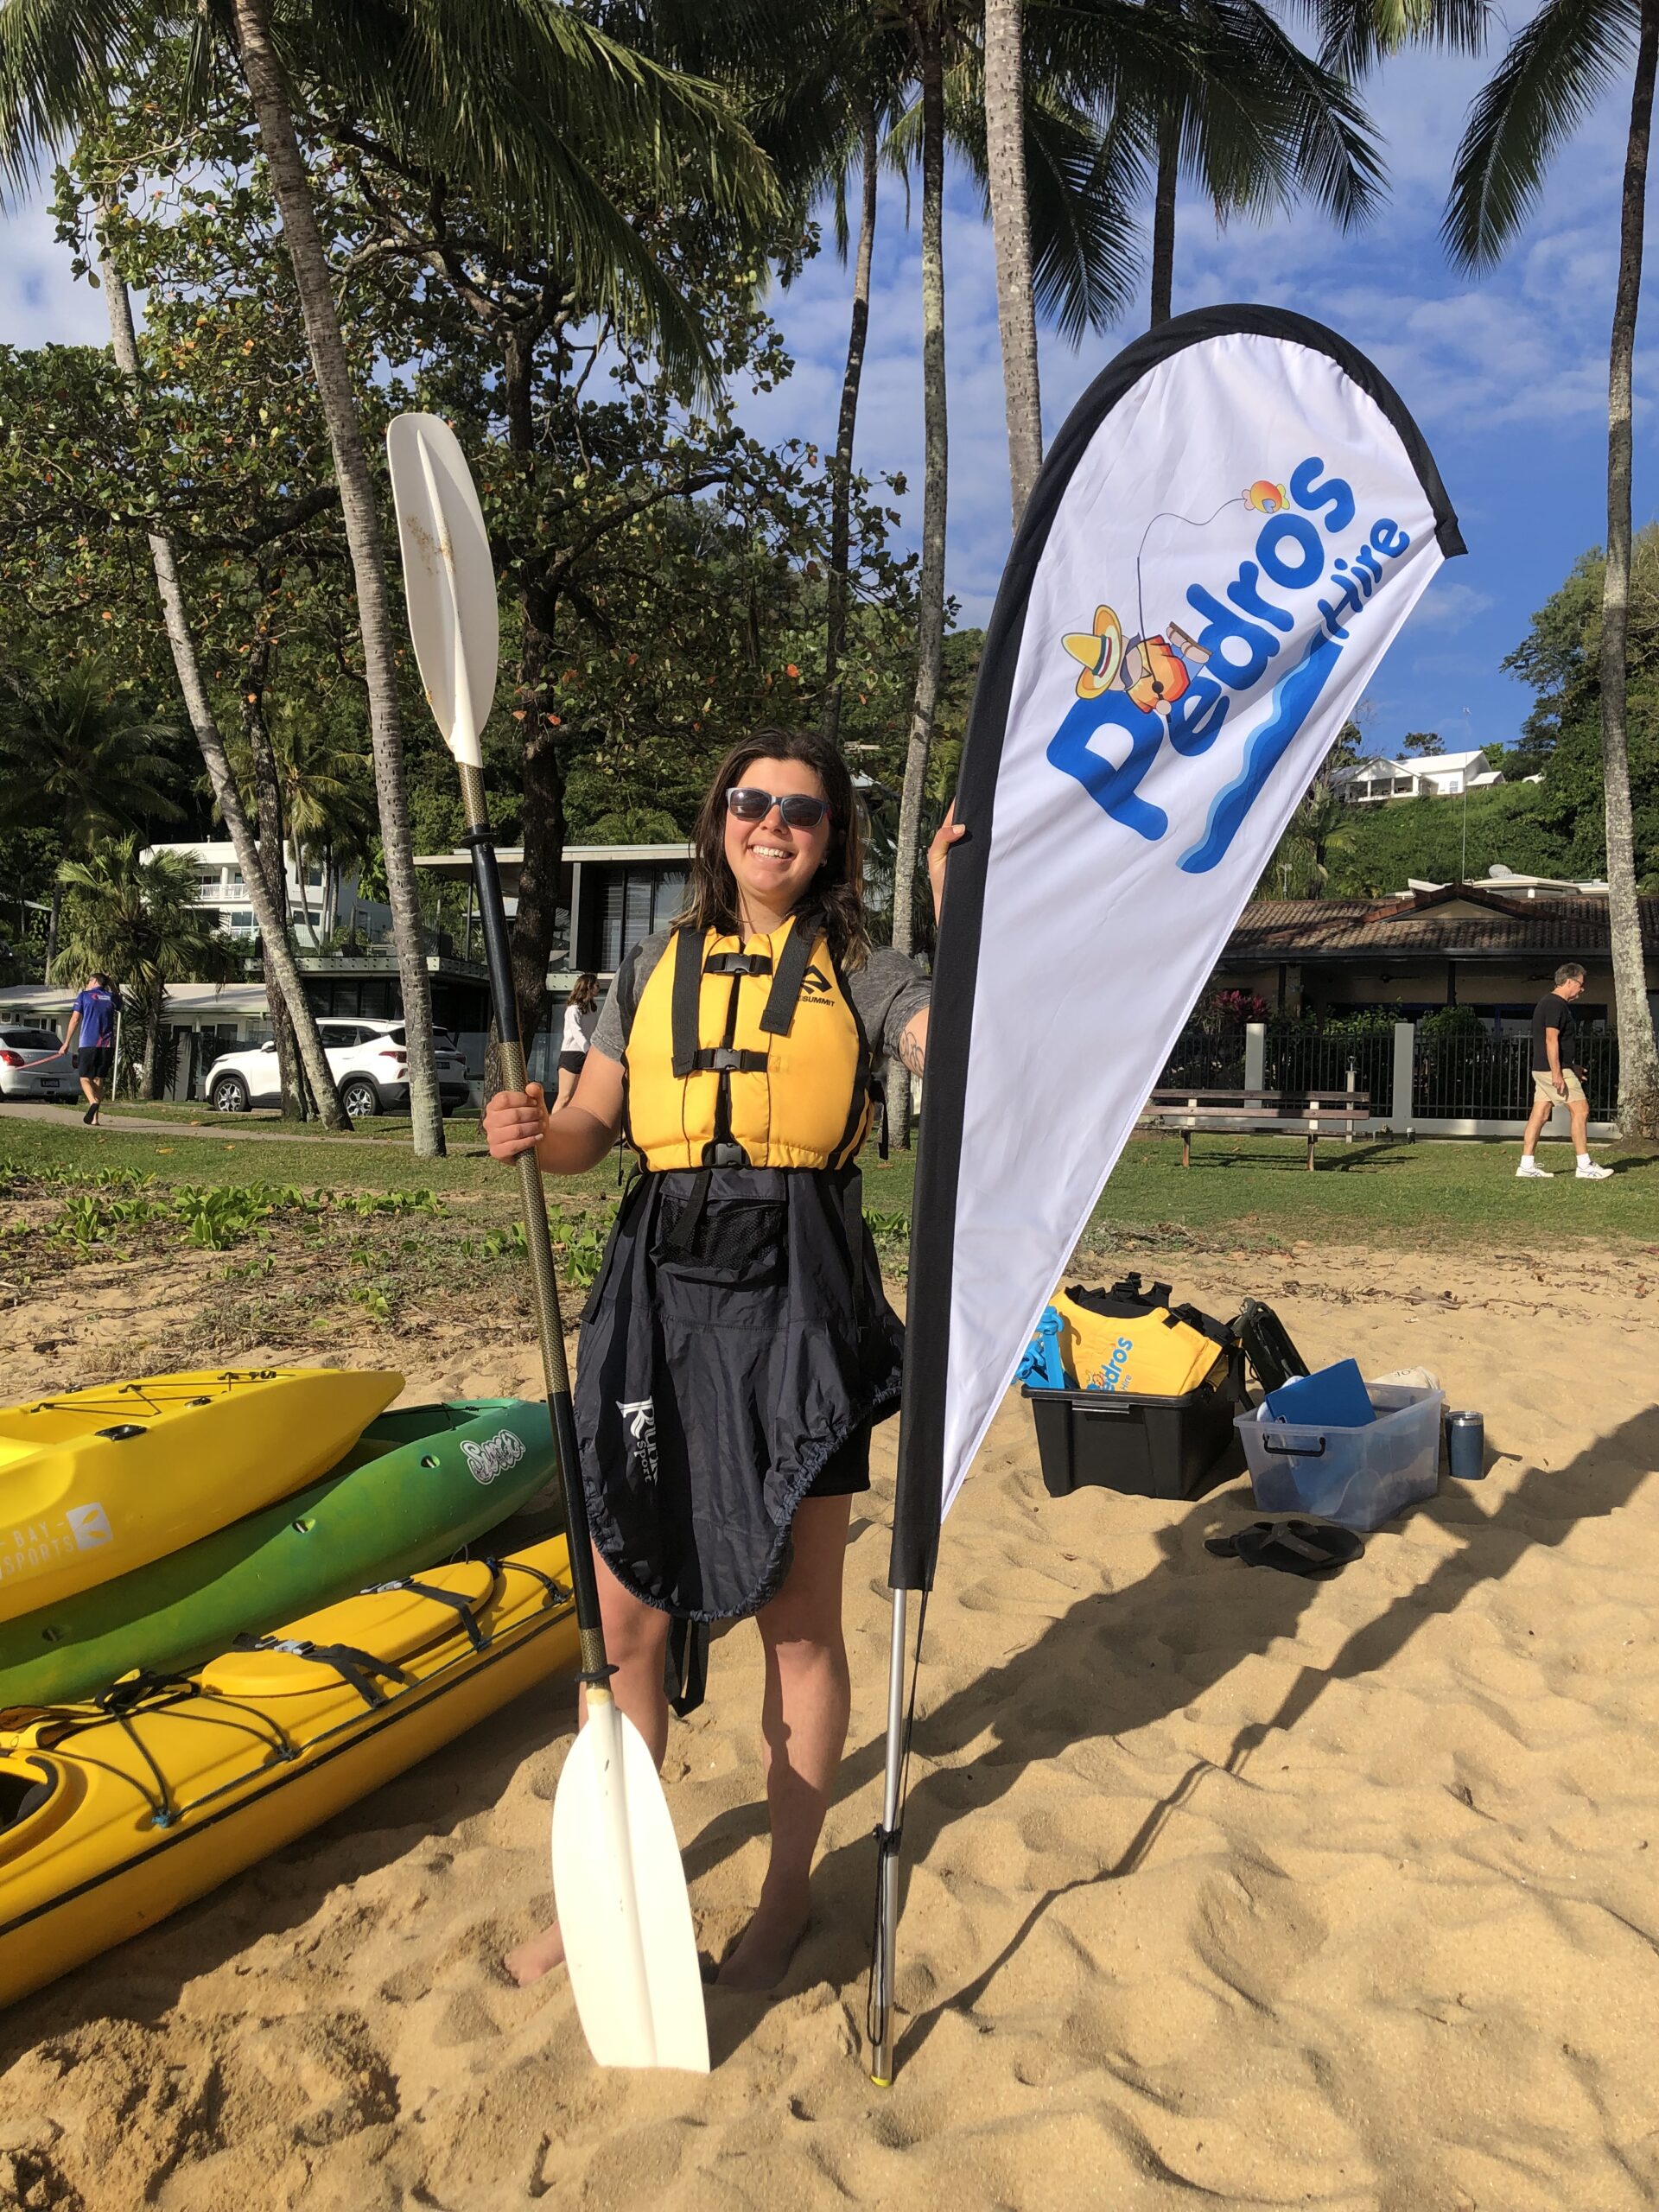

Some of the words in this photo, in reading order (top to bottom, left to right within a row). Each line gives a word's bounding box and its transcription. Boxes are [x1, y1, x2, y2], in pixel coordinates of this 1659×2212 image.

[1317, 517, 1411, 640] Hire
[1046, 456, 1356, 842] Pedros
[13, 1521, 49, 1548] BAY
